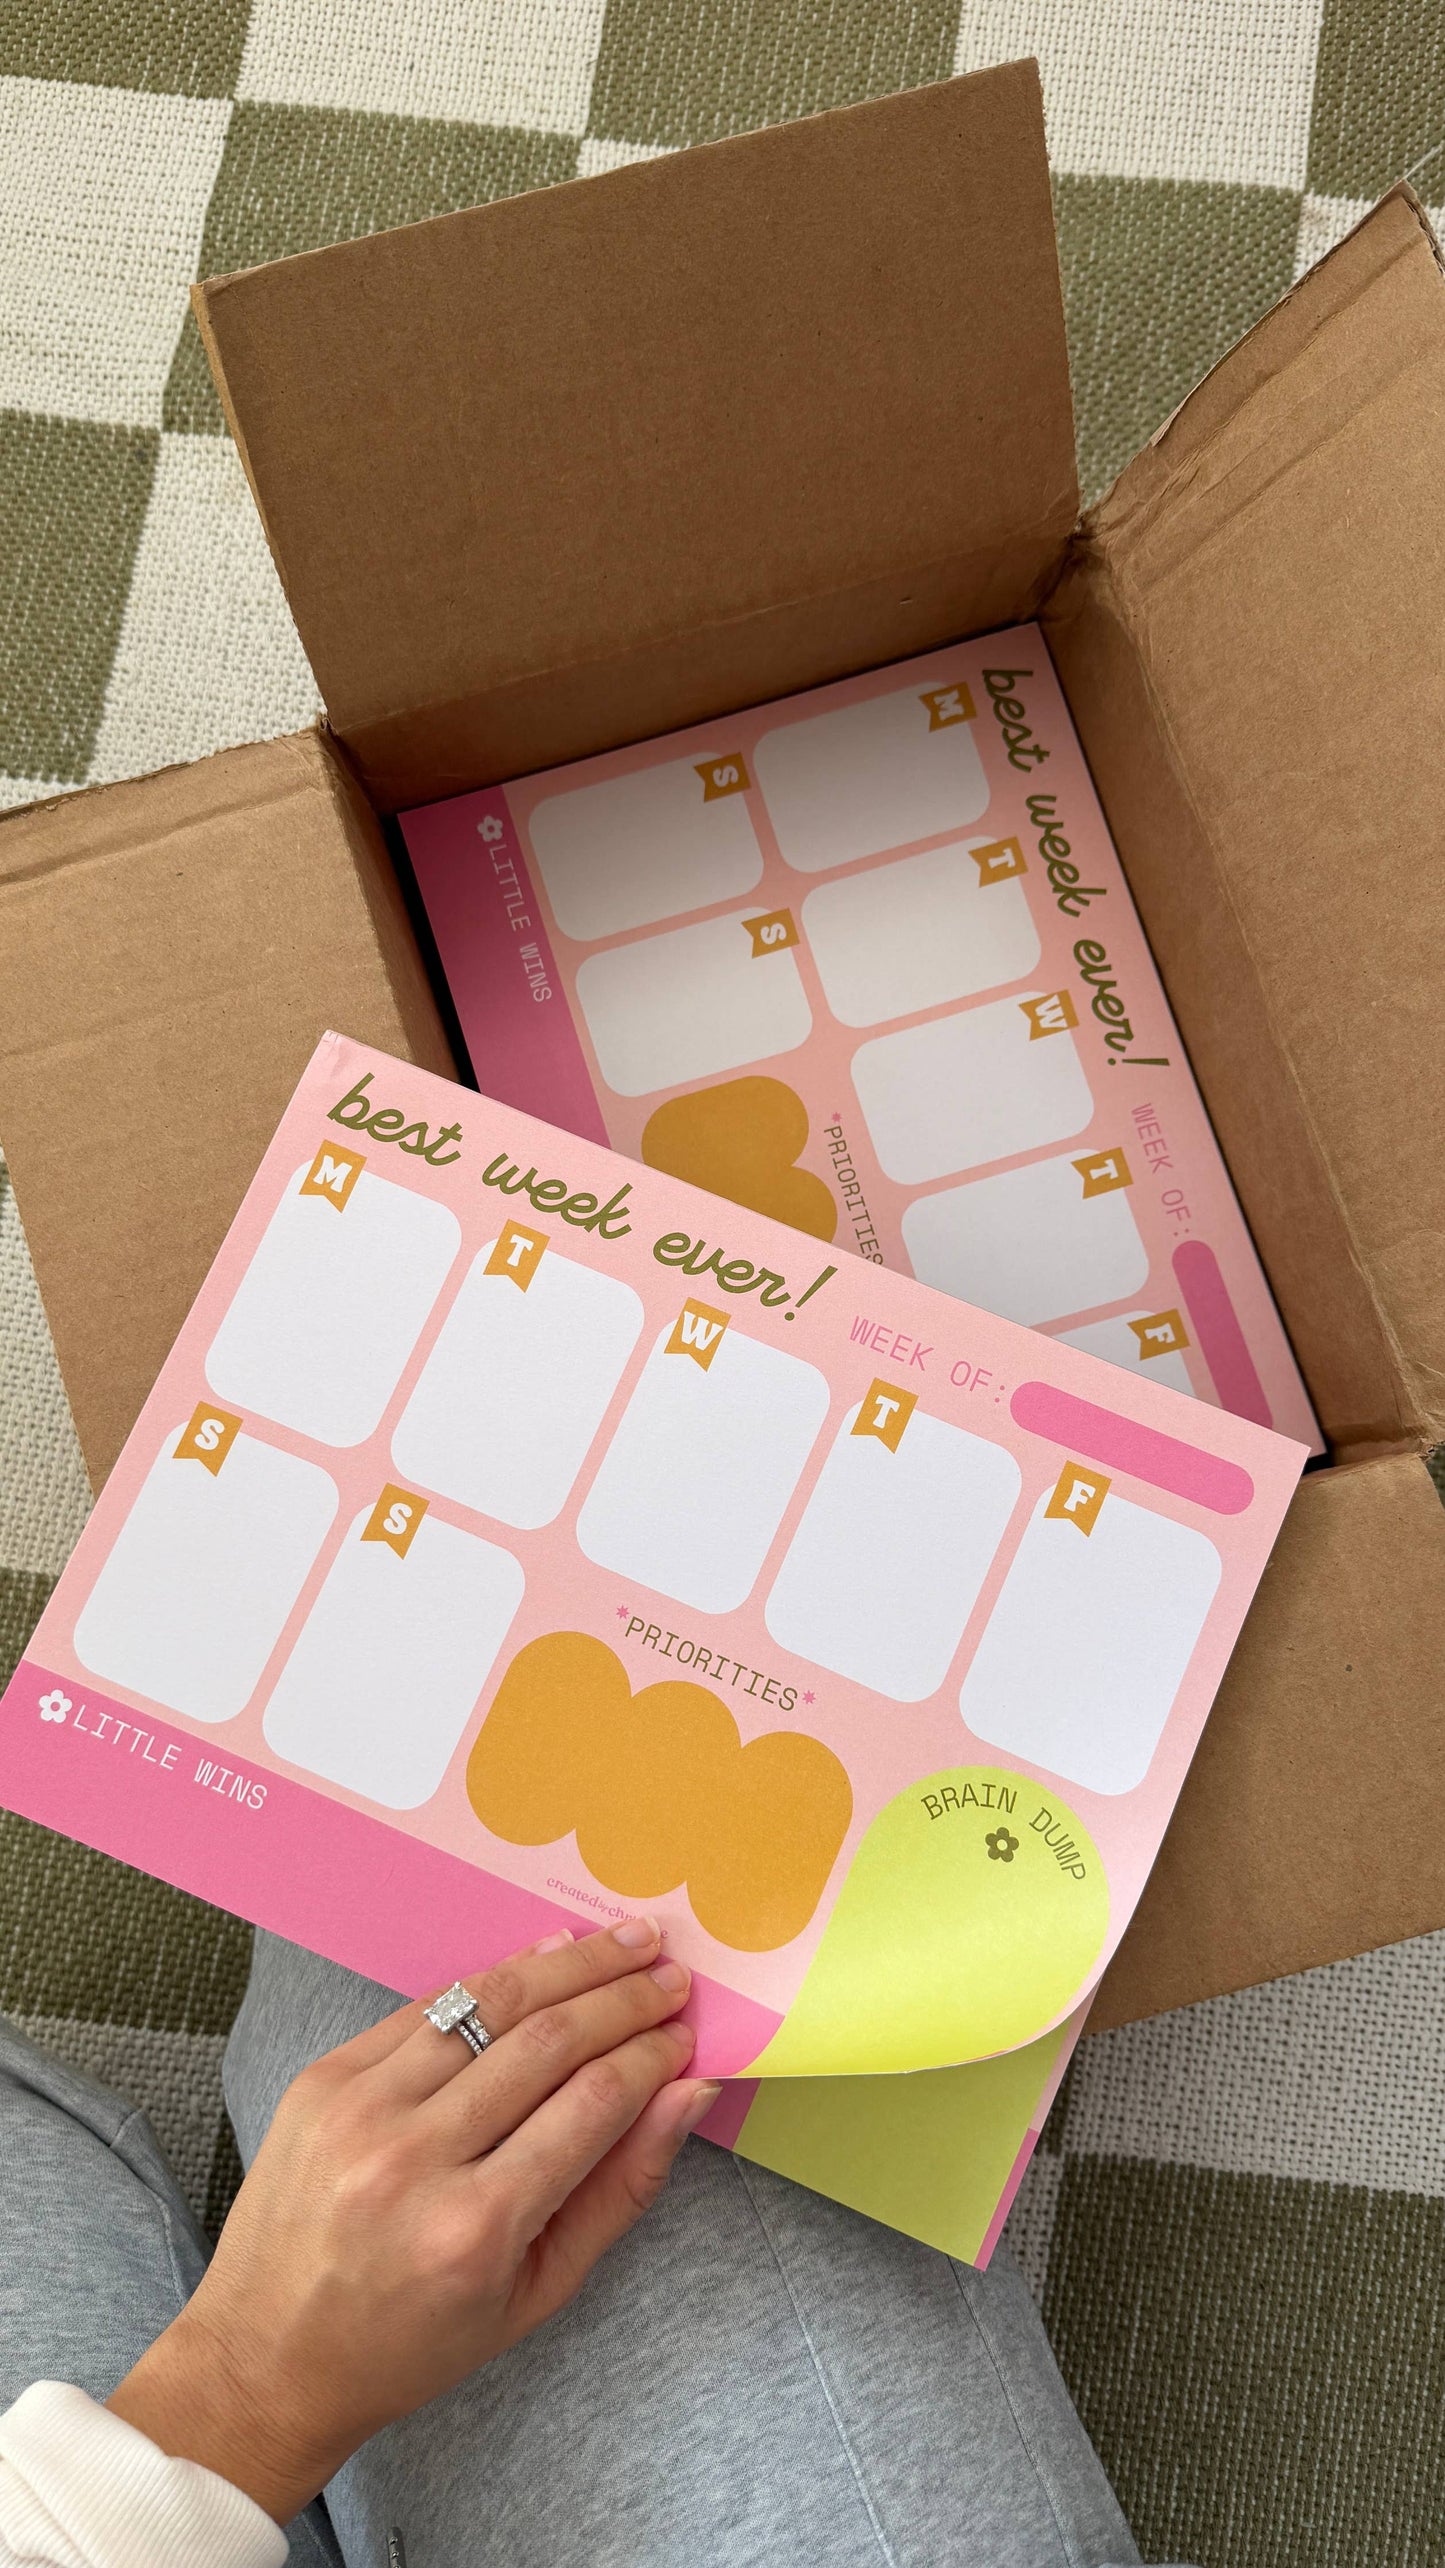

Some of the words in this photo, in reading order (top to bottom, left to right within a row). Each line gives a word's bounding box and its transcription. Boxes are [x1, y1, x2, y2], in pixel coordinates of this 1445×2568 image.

[933, 690, 965, 721] M
[712, 764, 739, 788] S
[982, 669, 1050, 773] best
[1025, 795, 1107, 918] week
[1073, 939, 1170, 1066] ever!
[988, 847, 1016, 869] T
[489, 845, 531, 932] LITTLE
[519, 942, 552, 1003] WINS
[760, 922, 787, 945] S
[1035, 994, 1069, 1028] W
[313, 1155, 353, 1193] M
[1089, 1158, 1119, 1180] T
[1131, 1103, 1173, 1174] WEEK
[1161, 1189, 1191, 1237] OF:
[326, 1072, 463, 1166] best
[482, 1153, 633, 1240] week
[652, 1232, 838, 1321] ever!
[507, 1234, 534, 1267] T
[681, 1310, 724, 1351] W
[1144, 1322, 1176, 1345] F
[848, 1315, 935, 1371] WEEK
[950, 1360, 1006, 1404] OF:
[872, 1395, 900, 1429] T
[194, 1418, 225, 1451] S
[1063, 1479, 1096, 1512] F
[382, 1502, 413, 1535] S
[73, 1704, 183, 1771] LITTLE
[194, 1758, 268, 1810] WINS
[920, 1783, 1017, 1820] BRAIN
[1029, 1807, 1086, 1880] DUMP
